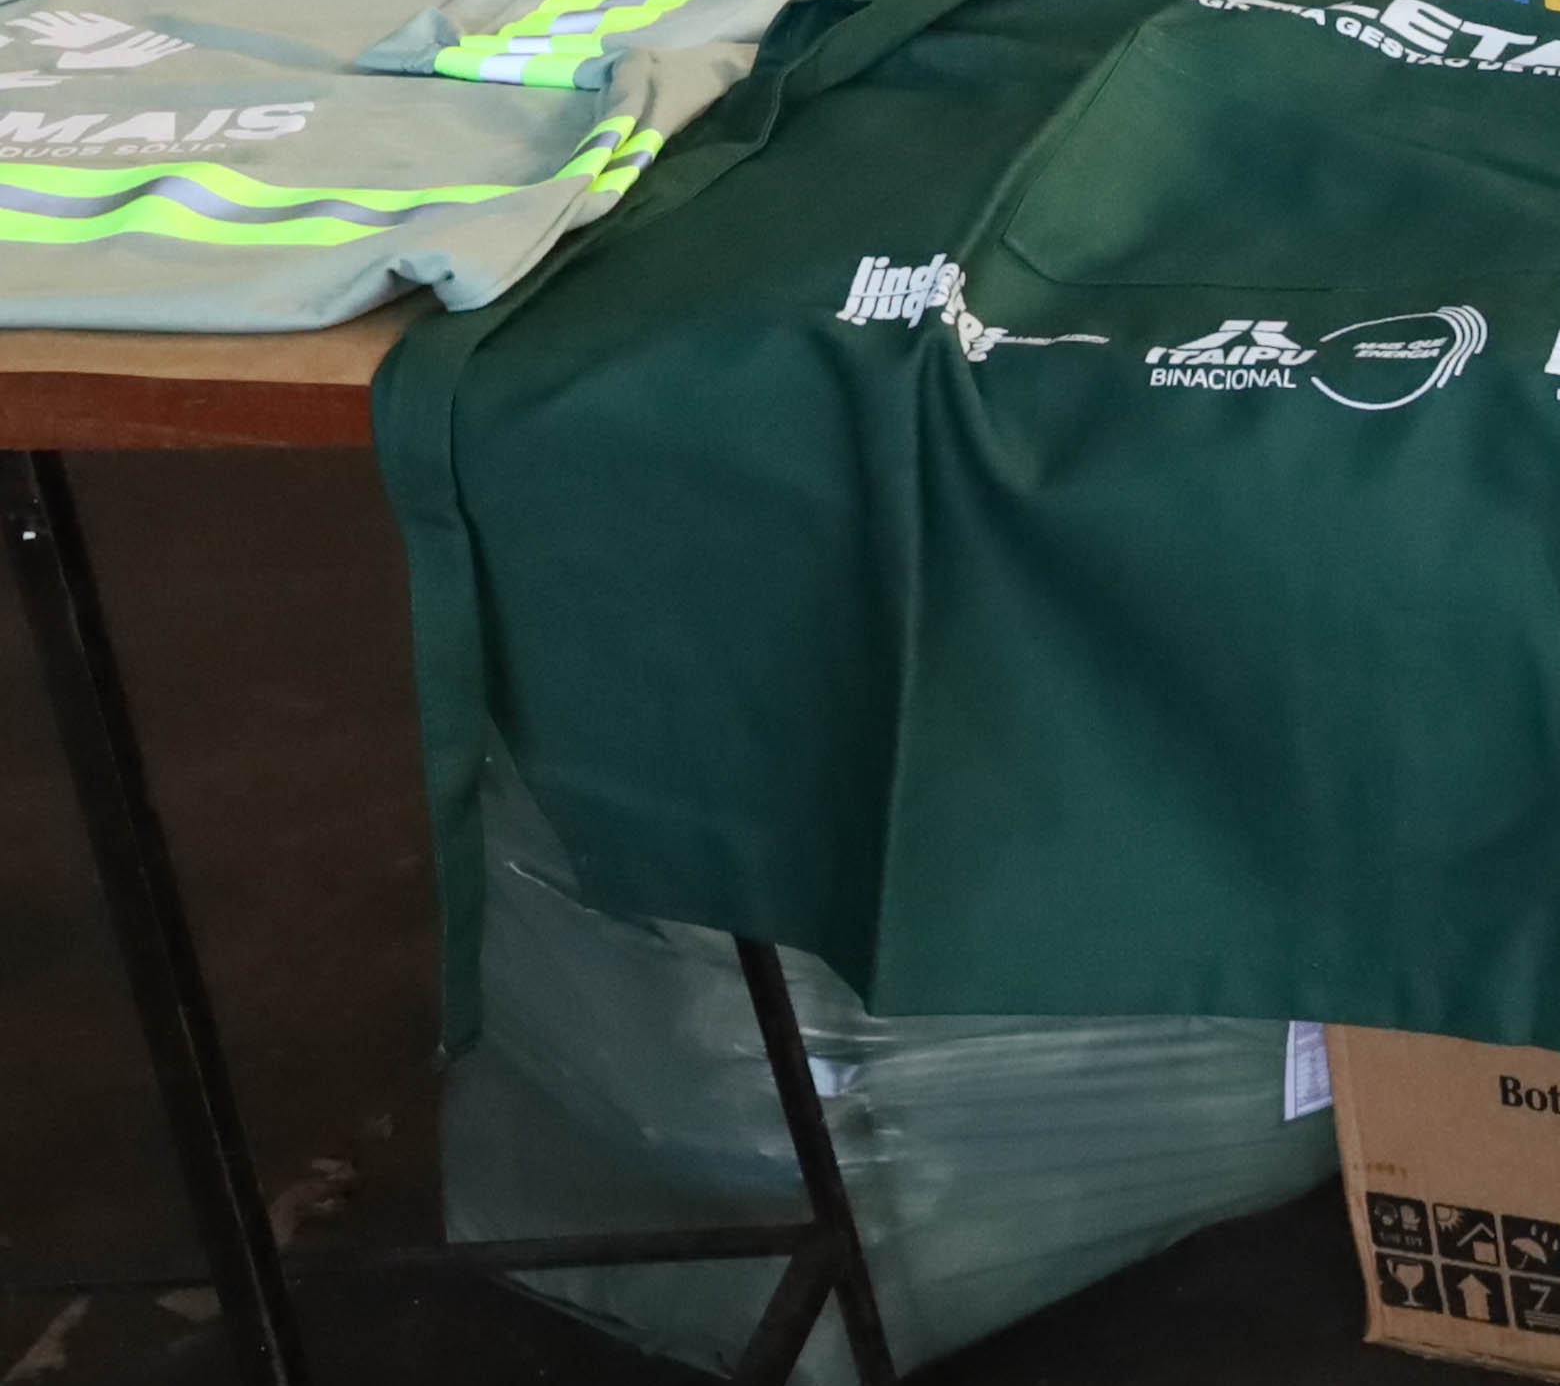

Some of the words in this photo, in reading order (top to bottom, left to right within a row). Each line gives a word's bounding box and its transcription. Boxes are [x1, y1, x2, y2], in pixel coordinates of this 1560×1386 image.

[0, 101, 315, 144] MAIS
[1145, 346, 1318, 365] ITAIPU
[1150, 368, 1297, 390] BINACIONAL
